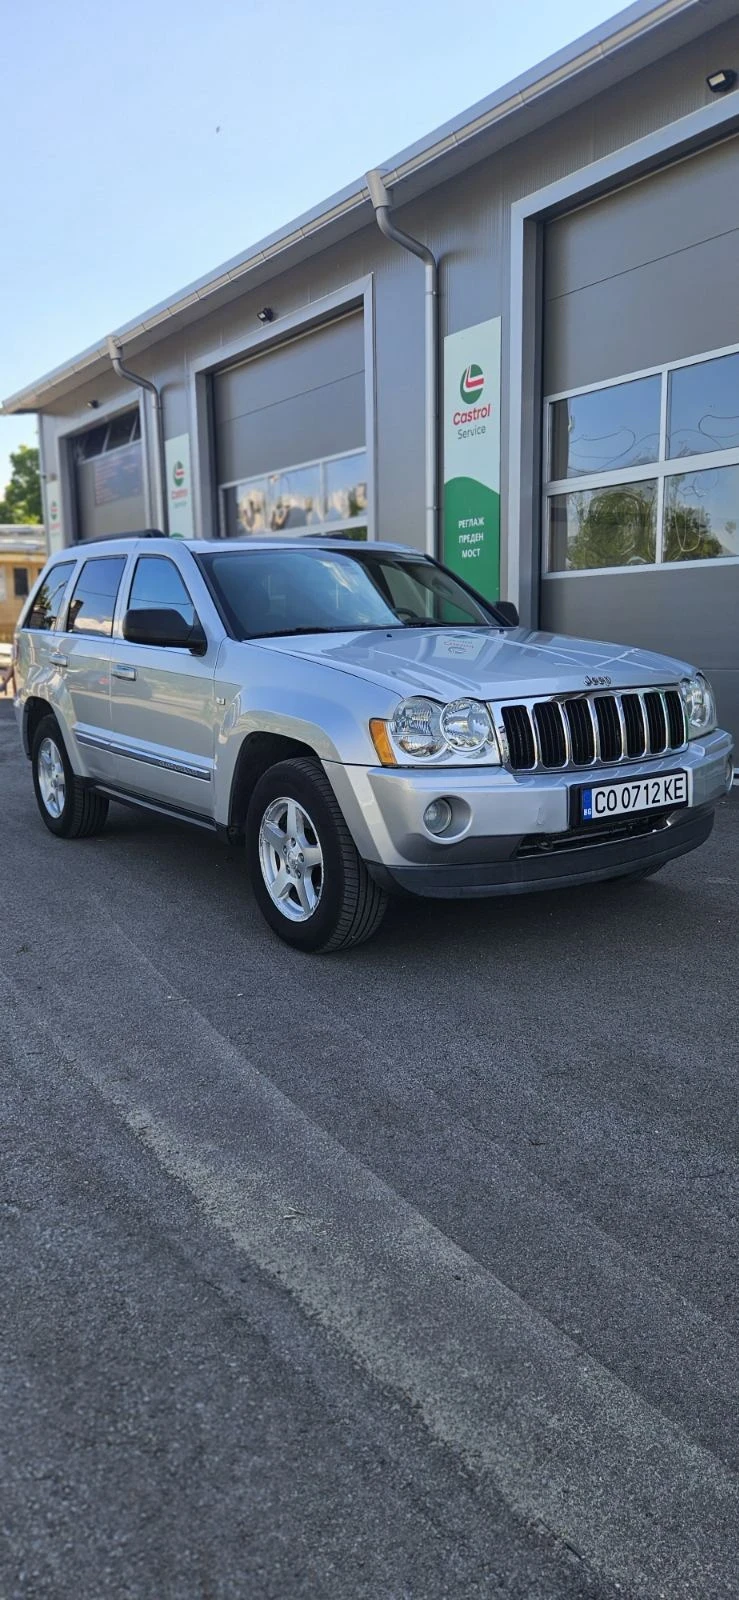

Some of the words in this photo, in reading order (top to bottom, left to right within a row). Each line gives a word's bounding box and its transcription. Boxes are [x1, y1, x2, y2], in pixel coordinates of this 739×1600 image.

[453, 403, 491, 426] Castrol
[457, 425, 486, 440] Service
[458, 517, 485, 528] РЕГЛАЖ
[458, 532, 484, 544] ПРЕДЕН
[461, 548, 480, 558] МОСТ
[584, 675, 612, 687] Jeep
[595, 789, 618, 814] CO
[621, 781, 661, 809] 0712
[664, 777, 684, 802] KE
[583, 808, 592, 816] BG
